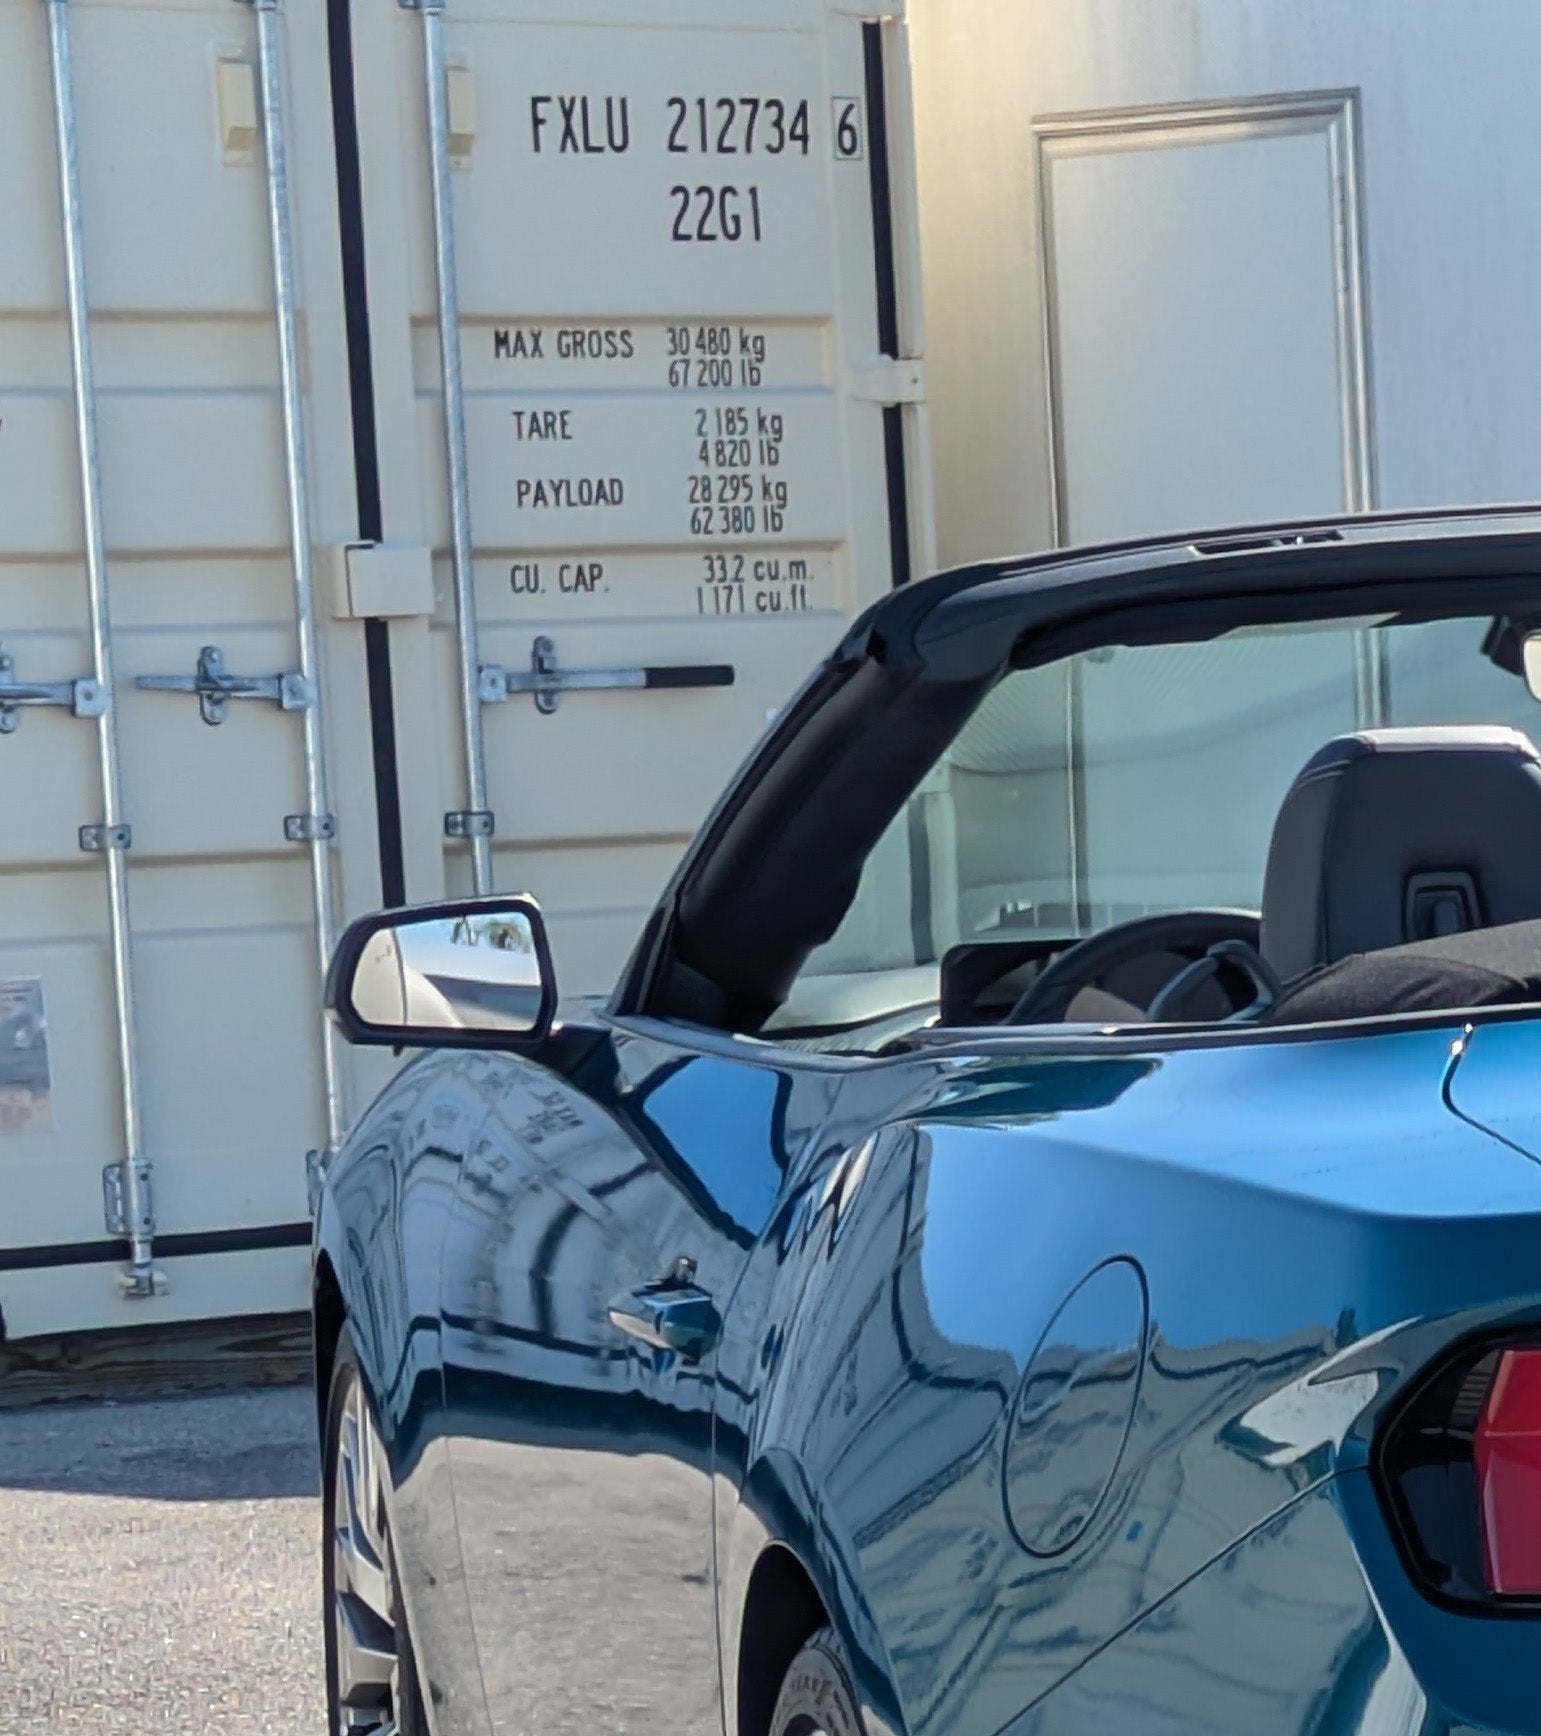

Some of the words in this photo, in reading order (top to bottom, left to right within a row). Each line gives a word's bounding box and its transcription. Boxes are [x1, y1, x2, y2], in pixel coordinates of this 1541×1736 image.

[529, 95, 631, 155] FXLU
[665, 95, 809, 156] 212734
[836, 103, 859, 156] 6
[669, 184, 763, 243] 22G1
[494, 330, 544, 360] MAX
[557, 330, 635, 359] GROSS
[739, 327, 766, 364] kg
[512, 409, 573, 442] TARE
[756, 406, 784, 444] kg
[516, 477, 624, 508] PAYLOAD
[761, 473, 788, 511] kg
[509, 563, 547, 594] CU.
[557, 563, 610, 593] CAP.
